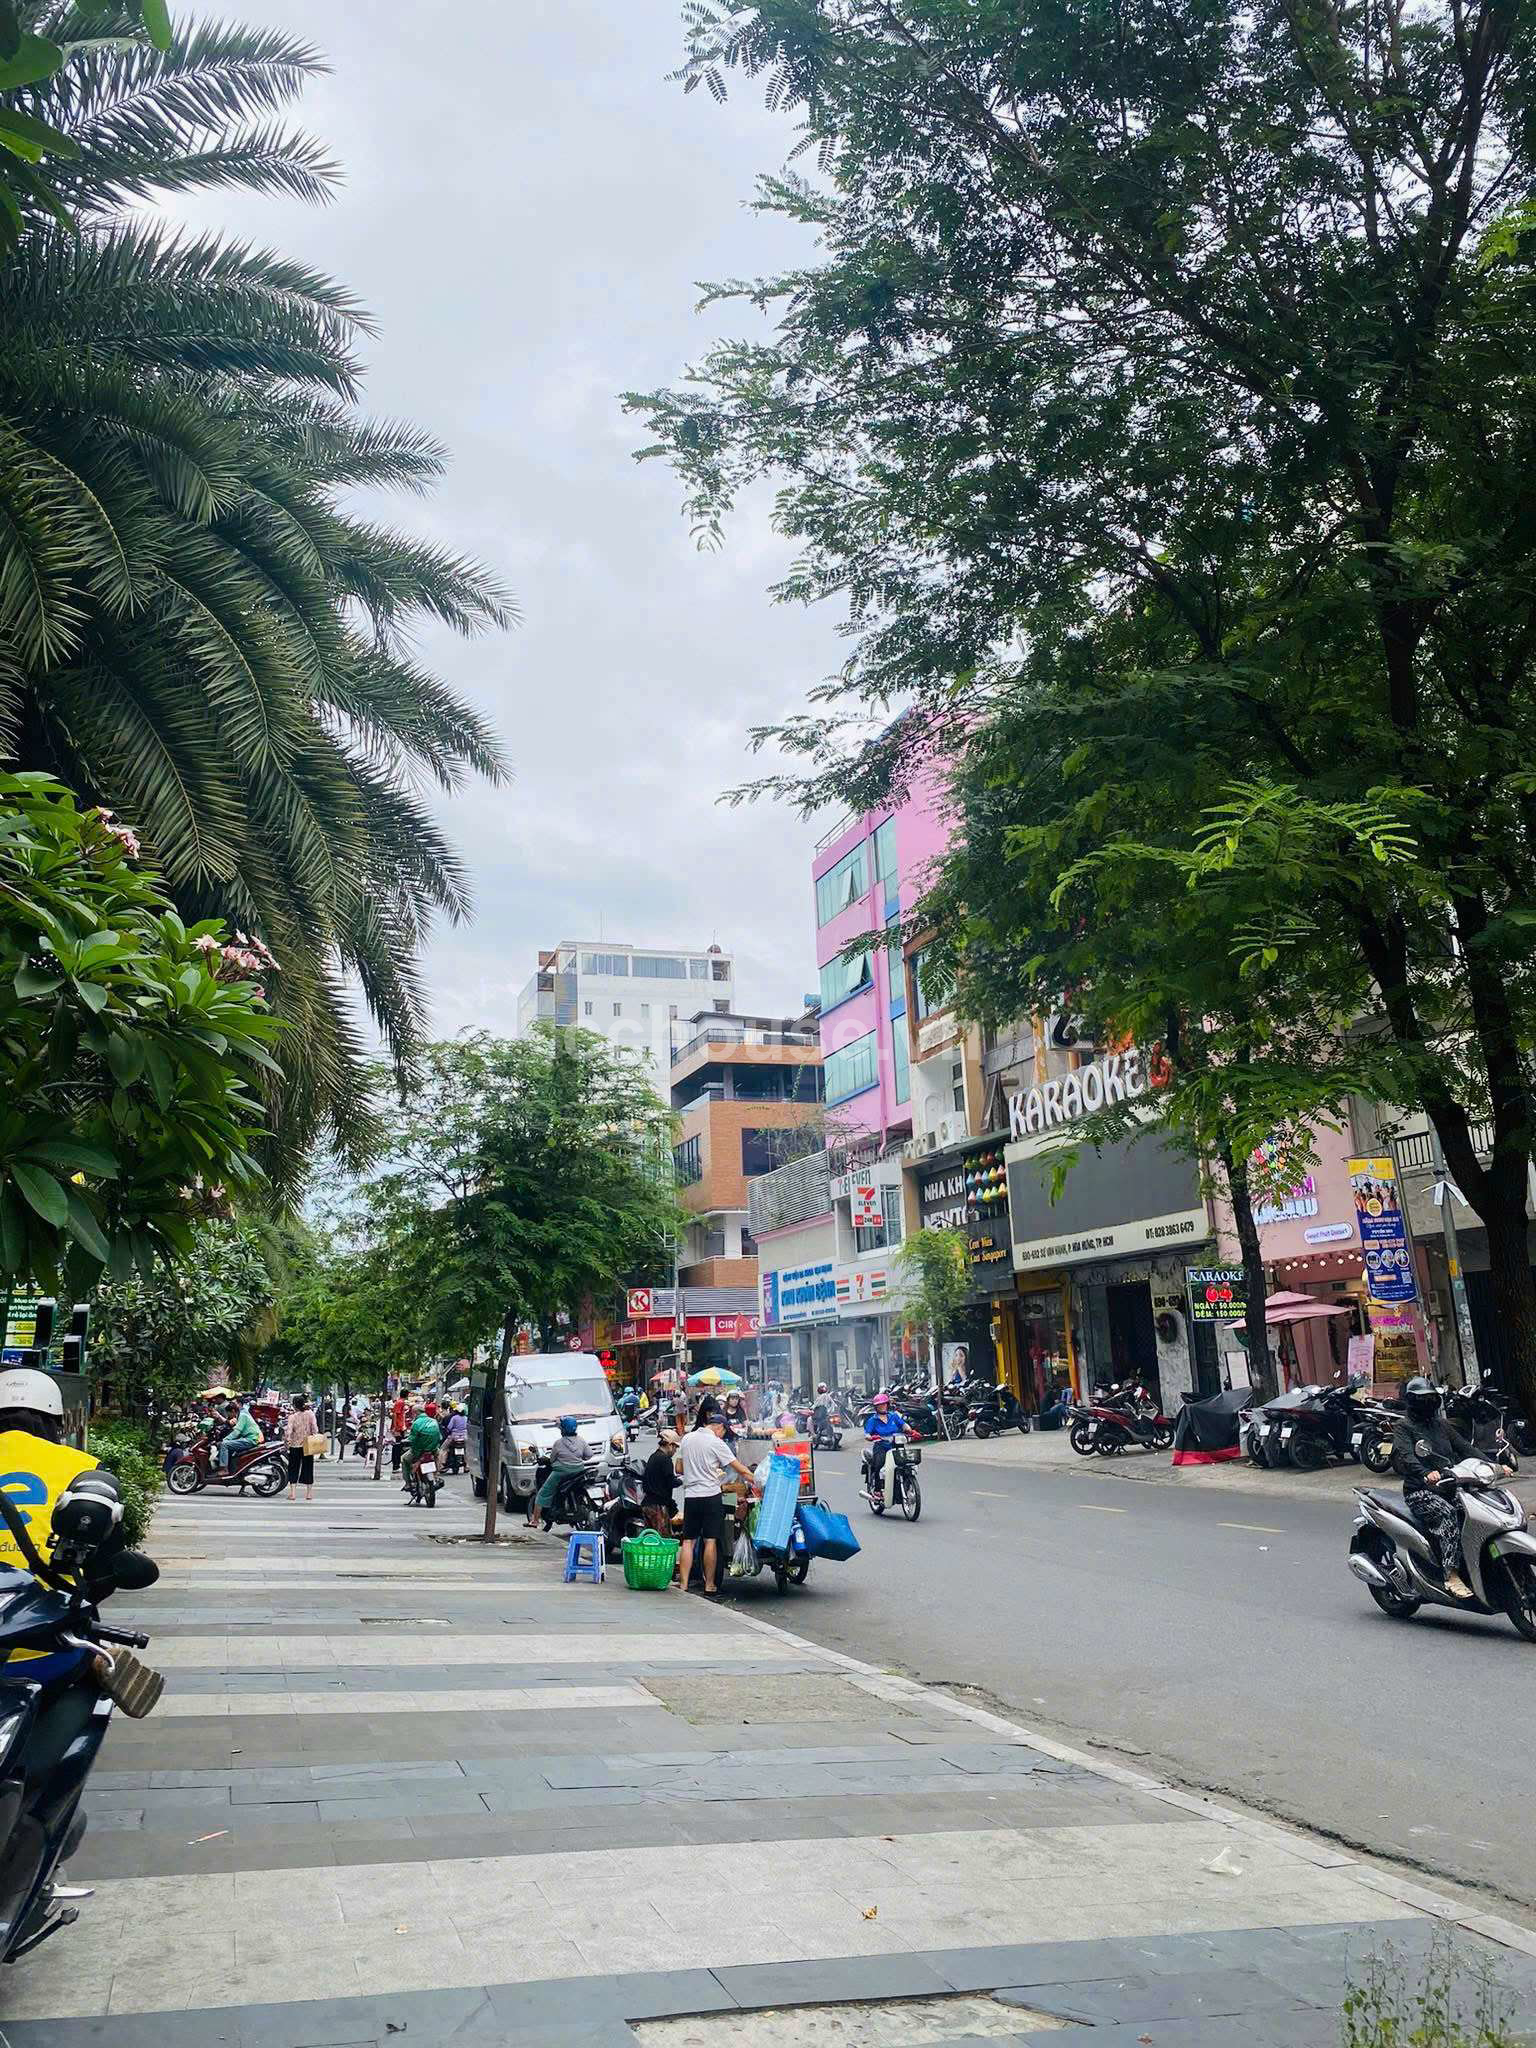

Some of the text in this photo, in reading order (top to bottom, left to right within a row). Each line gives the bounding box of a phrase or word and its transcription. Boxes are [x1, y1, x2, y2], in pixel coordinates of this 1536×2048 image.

[1009, 1050, 1144, 1142] KARAOKE
[924, 1181, 946, 1202] NHA
[1190, 1270, 1244, 1281] KARAOKE
